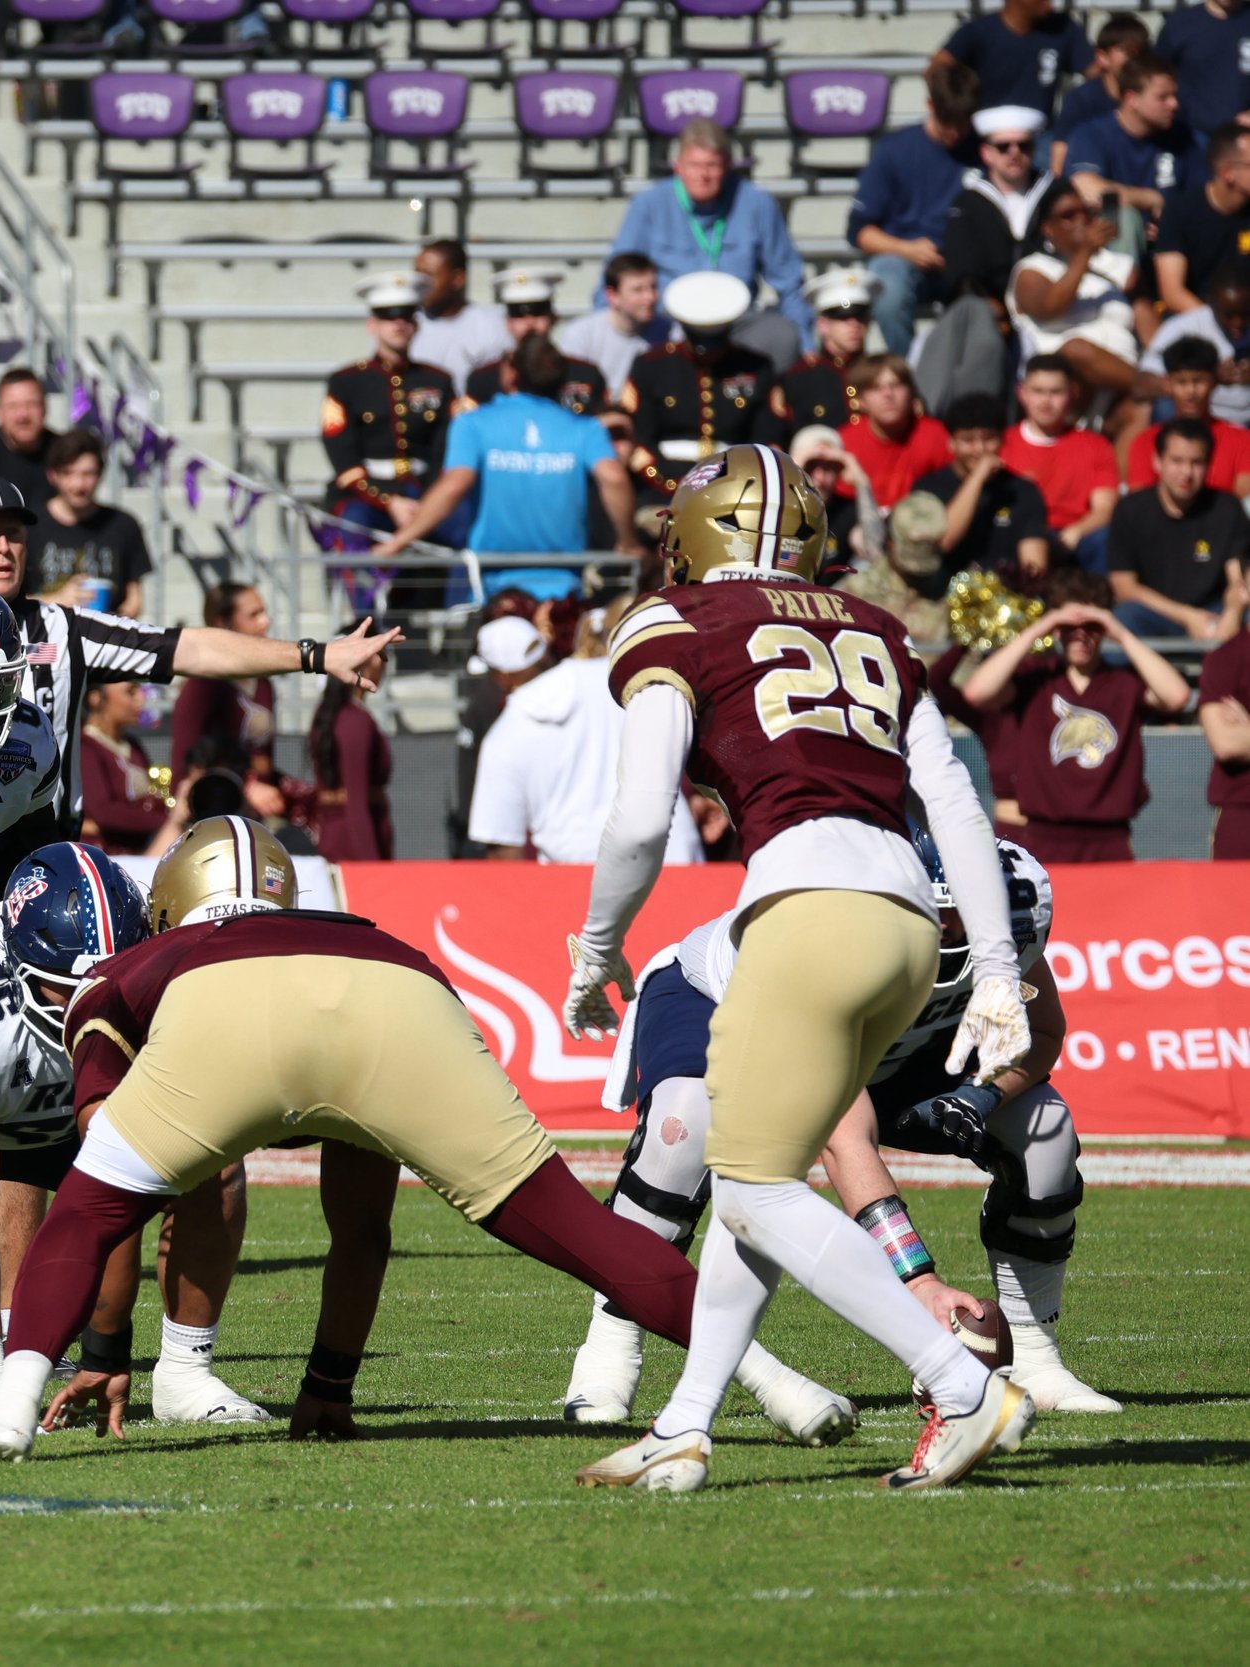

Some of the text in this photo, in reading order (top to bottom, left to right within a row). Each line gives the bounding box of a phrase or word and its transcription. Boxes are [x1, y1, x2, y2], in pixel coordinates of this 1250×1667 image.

[115, 92, 171, 121] TCU
[247, 89, 303, 119] TCU
[388, 87, 444, 117] TCU
[540, 88, 595, 117] TCU
[662, 88, 717, 119] TCU
[811, 86, 866, 115] TCU
[487, 449, 575, 474] EVENT STAFF
[781, 538, 804, 554] SBC
[758, 587, 855, 623] PAYNE
[746, 624, 902, 757] 29
[265, 865, 285, 882] SBC
[206, 903, 247, 919] TEXAS
[1044, 935, 1250, 993] orces
[1146, 1027, 1250, 1071] REN
